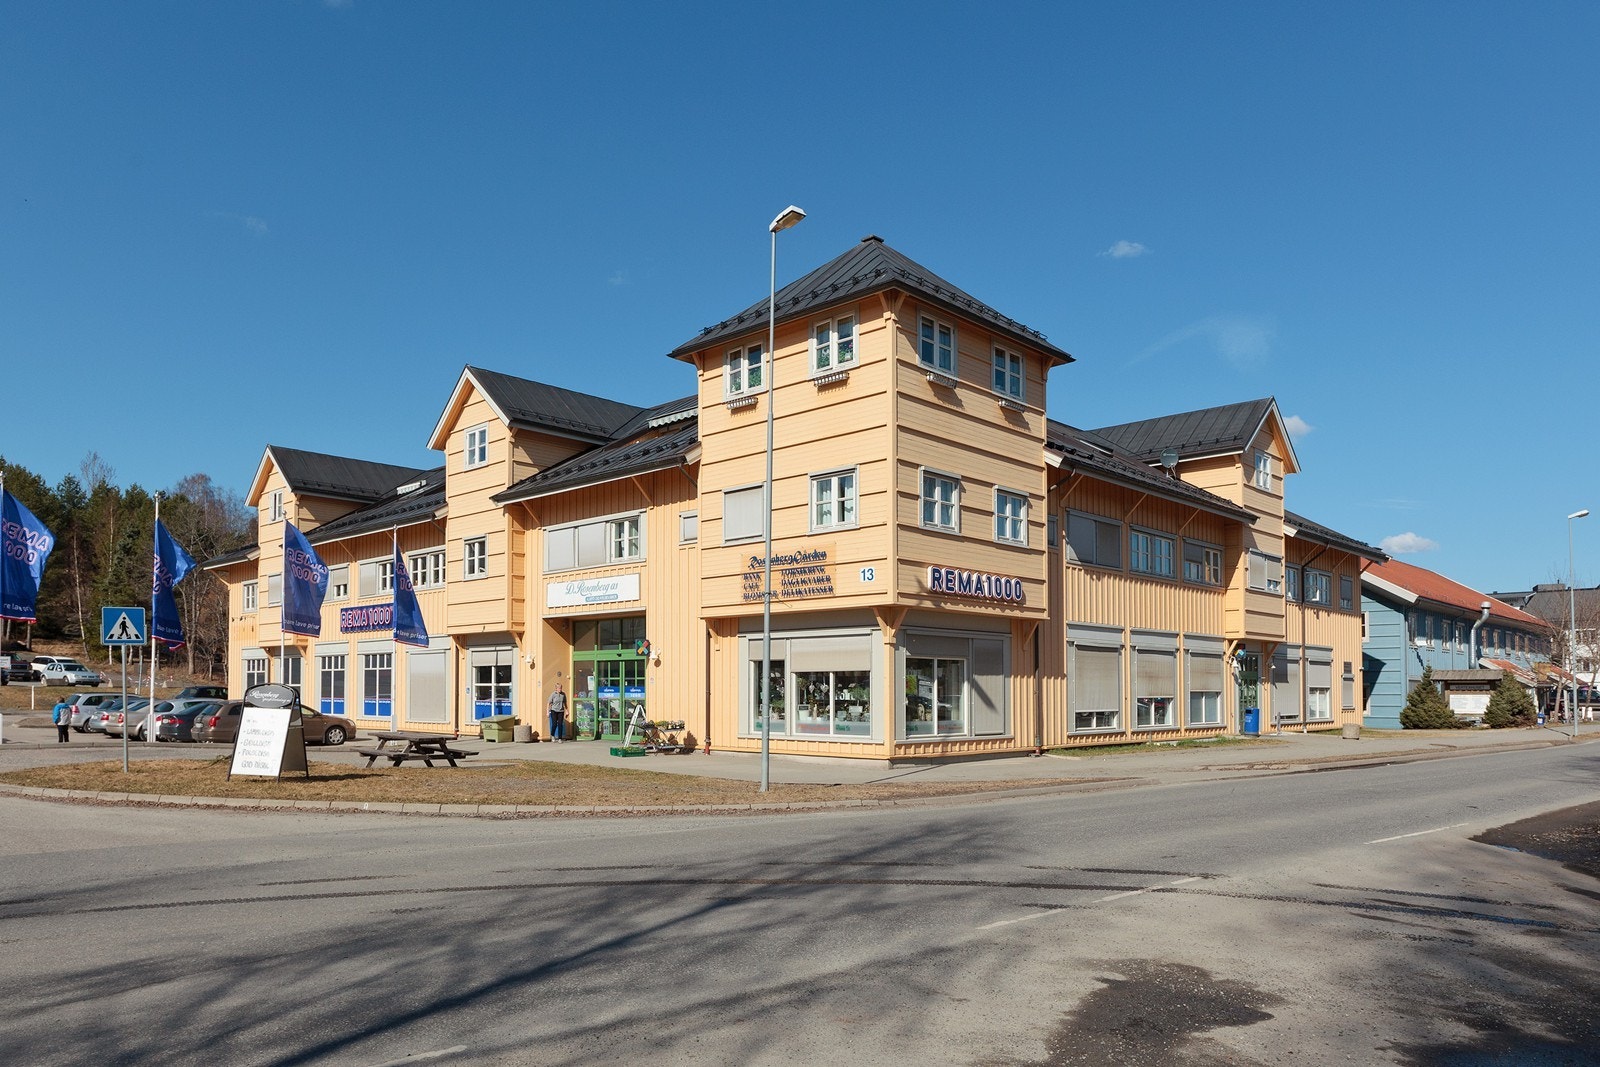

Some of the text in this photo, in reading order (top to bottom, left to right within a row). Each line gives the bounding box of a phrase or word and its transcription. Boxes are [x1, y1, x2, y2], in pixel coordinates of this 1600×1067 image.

[6, 541, 38, 565] 000
[287, 548, 328, 574] REMA
[748, 553, 793, 570] Rosnberg
[292, 564, 320, 584] 1000
[861, 568, 874, 581] 13
[341, 606, 391, 628] REMA 1000
